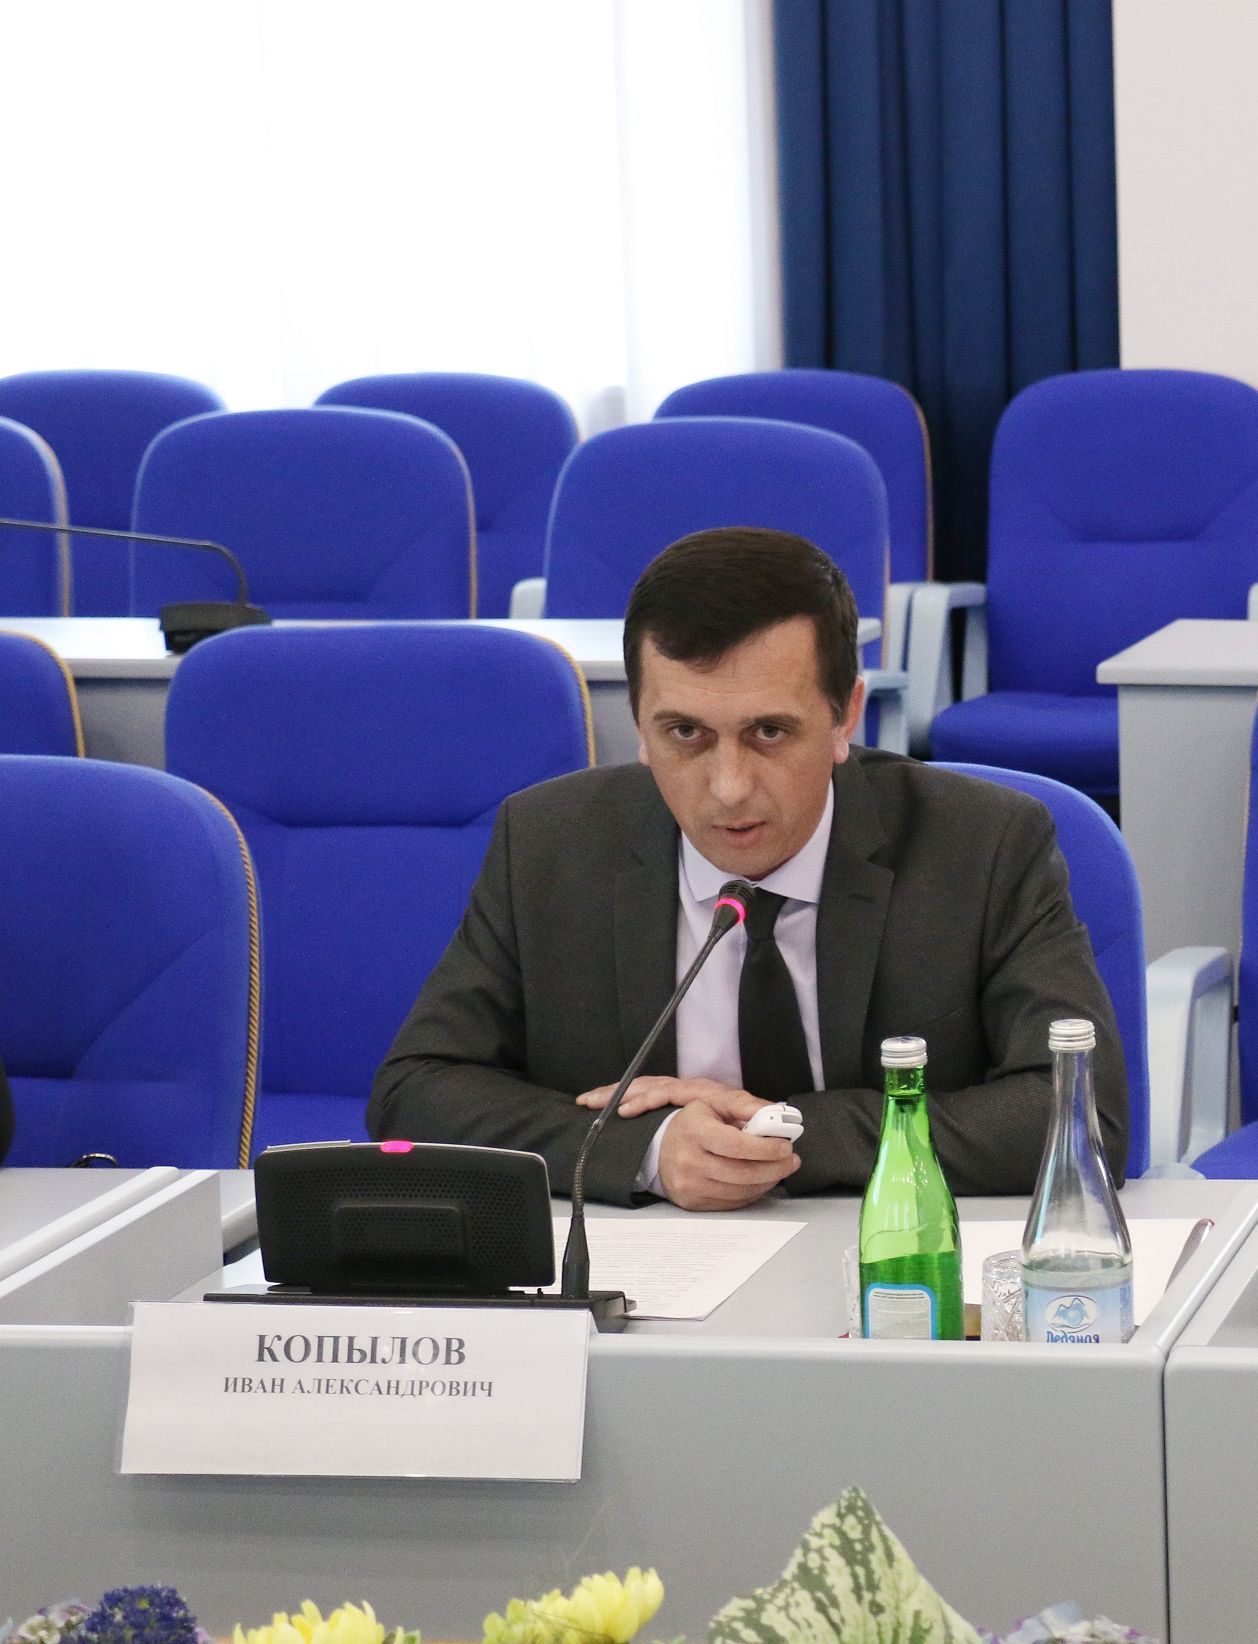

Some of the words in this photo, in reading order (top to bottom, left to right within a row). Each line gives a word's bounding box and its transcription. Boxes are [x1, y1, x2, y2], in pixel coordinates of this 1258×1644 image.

[254, 1333, 467, 1366] КОПЫЛОВ
[222, 1376, 286, 1394] ИВАН
[291, 1379, 494, 1398] АЛЕКСАНДРОВИЧ
